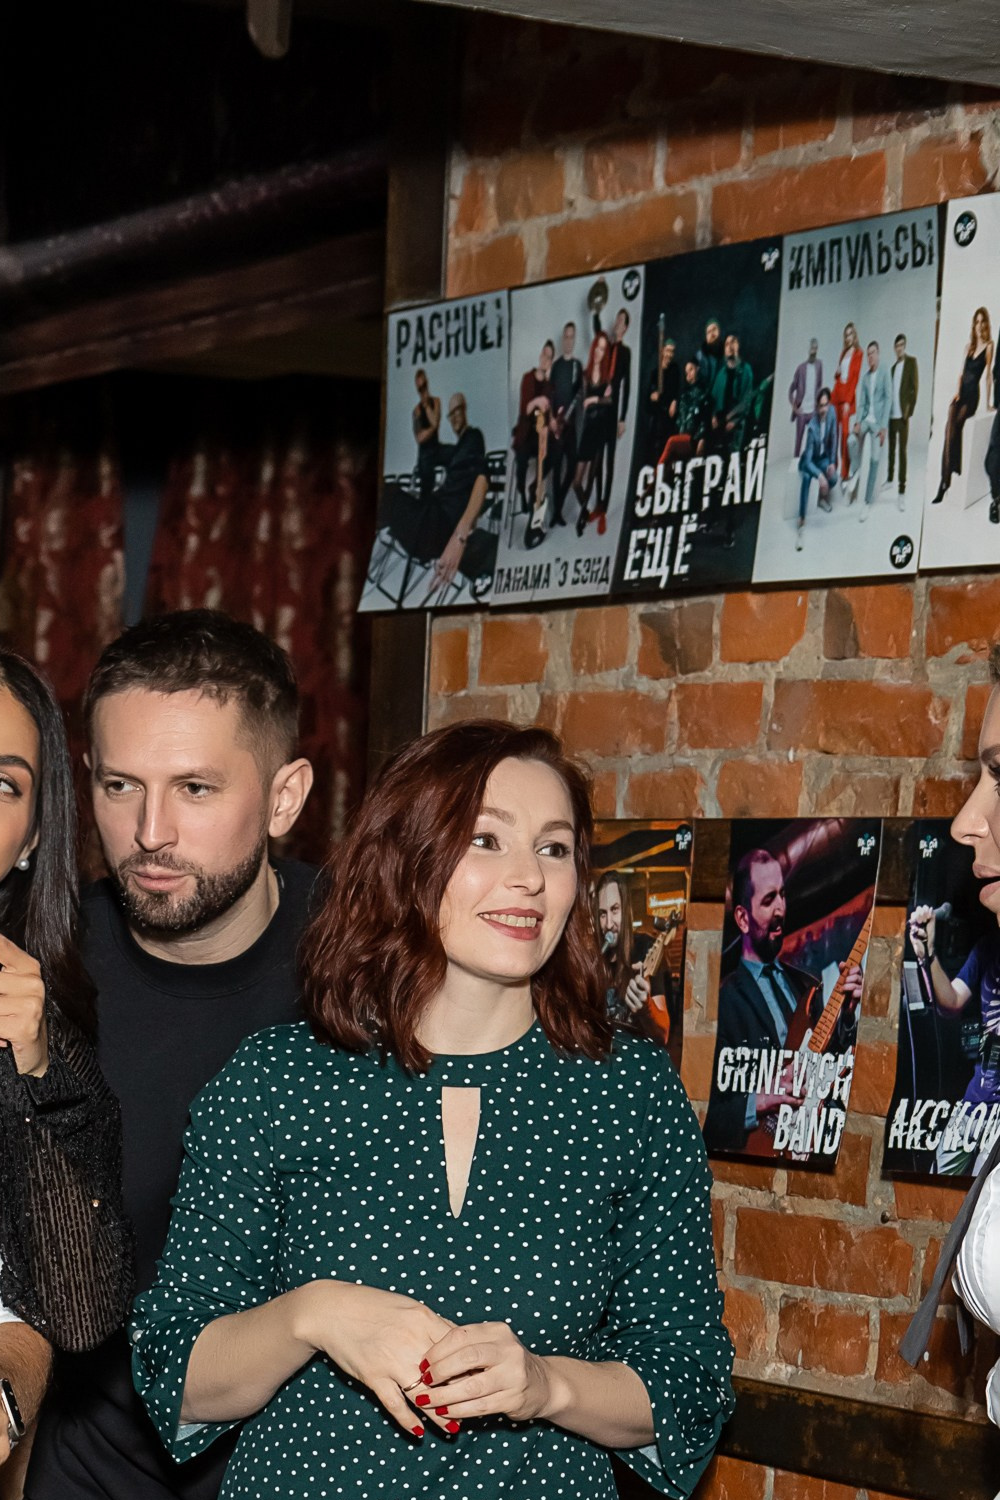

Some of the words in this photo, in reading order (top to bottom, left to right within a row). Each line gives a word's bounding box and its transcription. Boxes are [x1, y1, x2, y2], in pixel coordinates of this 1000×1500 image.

[788, 218, 934, 290] ИМПУЛЬСЫ
[634, 433, 767, 518] СЫГРАЙ
[623, 513, 698, 589] ЕЩЁ
[717, 1046, 855, 1102] GRINEVICH
[773, 1103, 847, 1155] BAND
